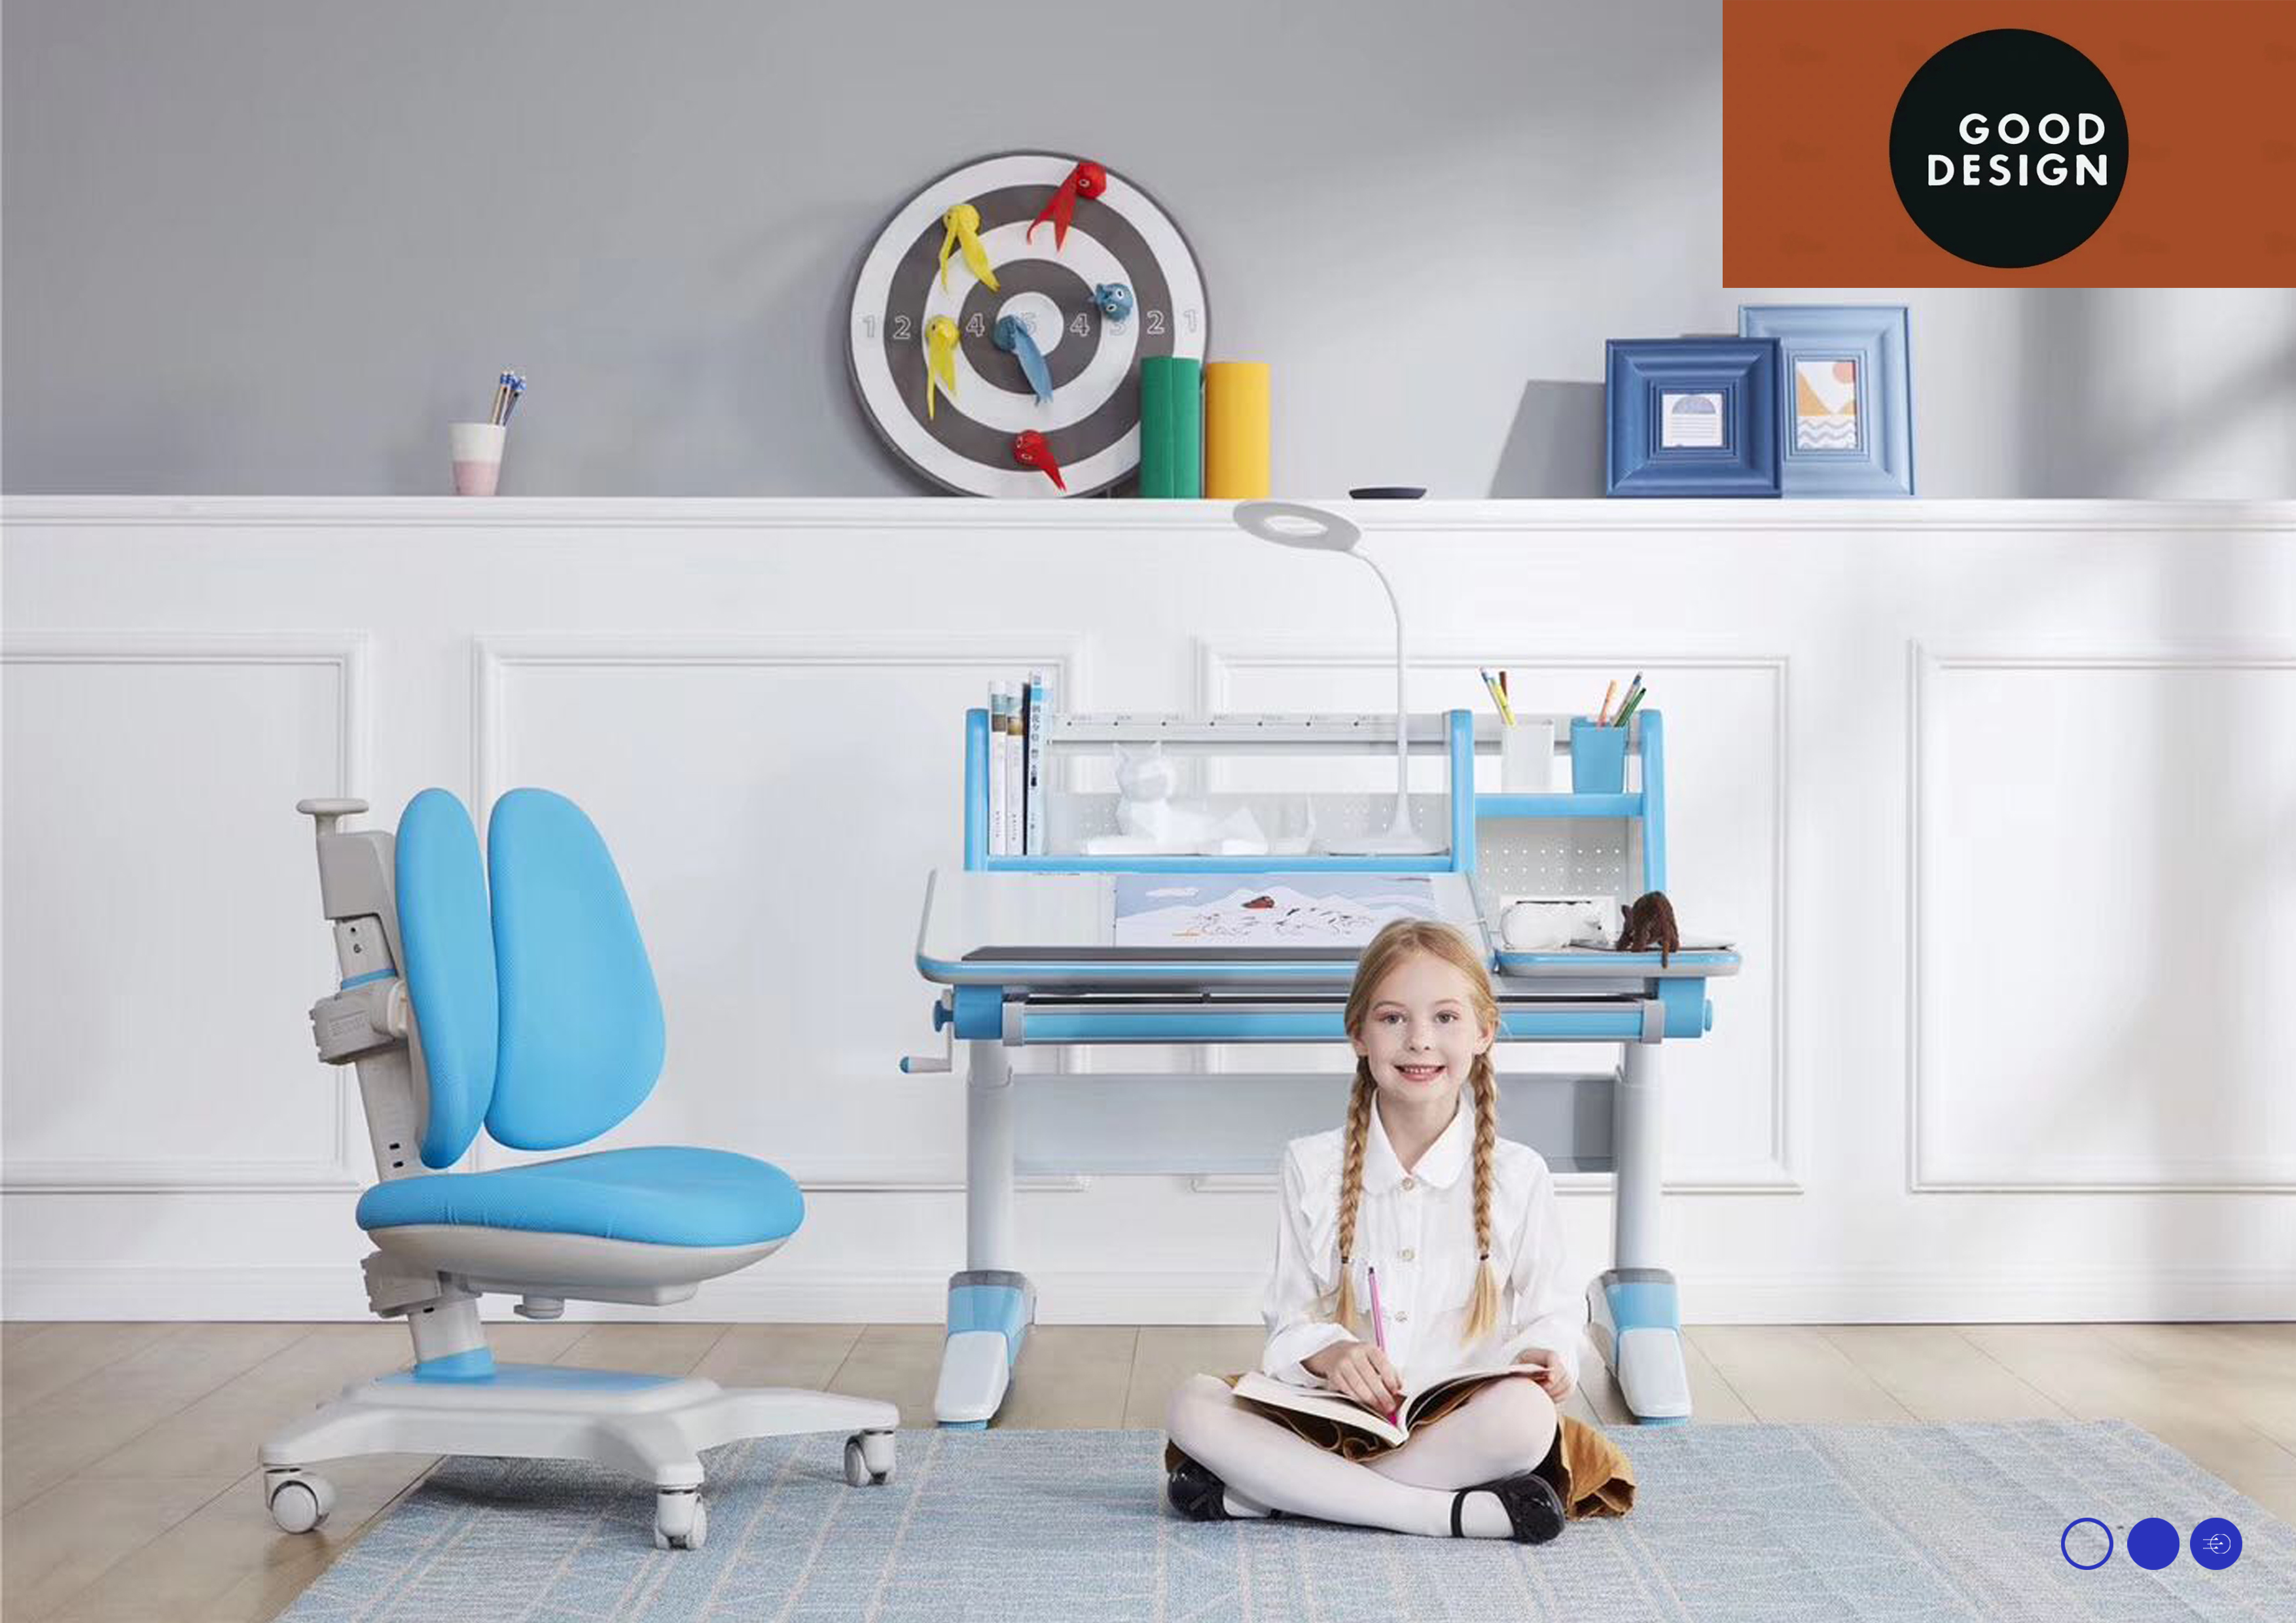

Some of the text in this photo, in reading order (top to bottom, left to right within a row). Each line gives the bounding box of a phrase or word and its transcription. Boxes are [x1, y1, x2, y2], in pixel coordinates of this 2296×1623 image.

[862, 314, 875, 338] 1
[893, 315, 911, 340] 2
[965, 313, 985, 338] 4
[1069, 313, 1090, 337] 4
[1146, 310, 1166, 334] 2
[1183, 309, 1197, 334] 1
